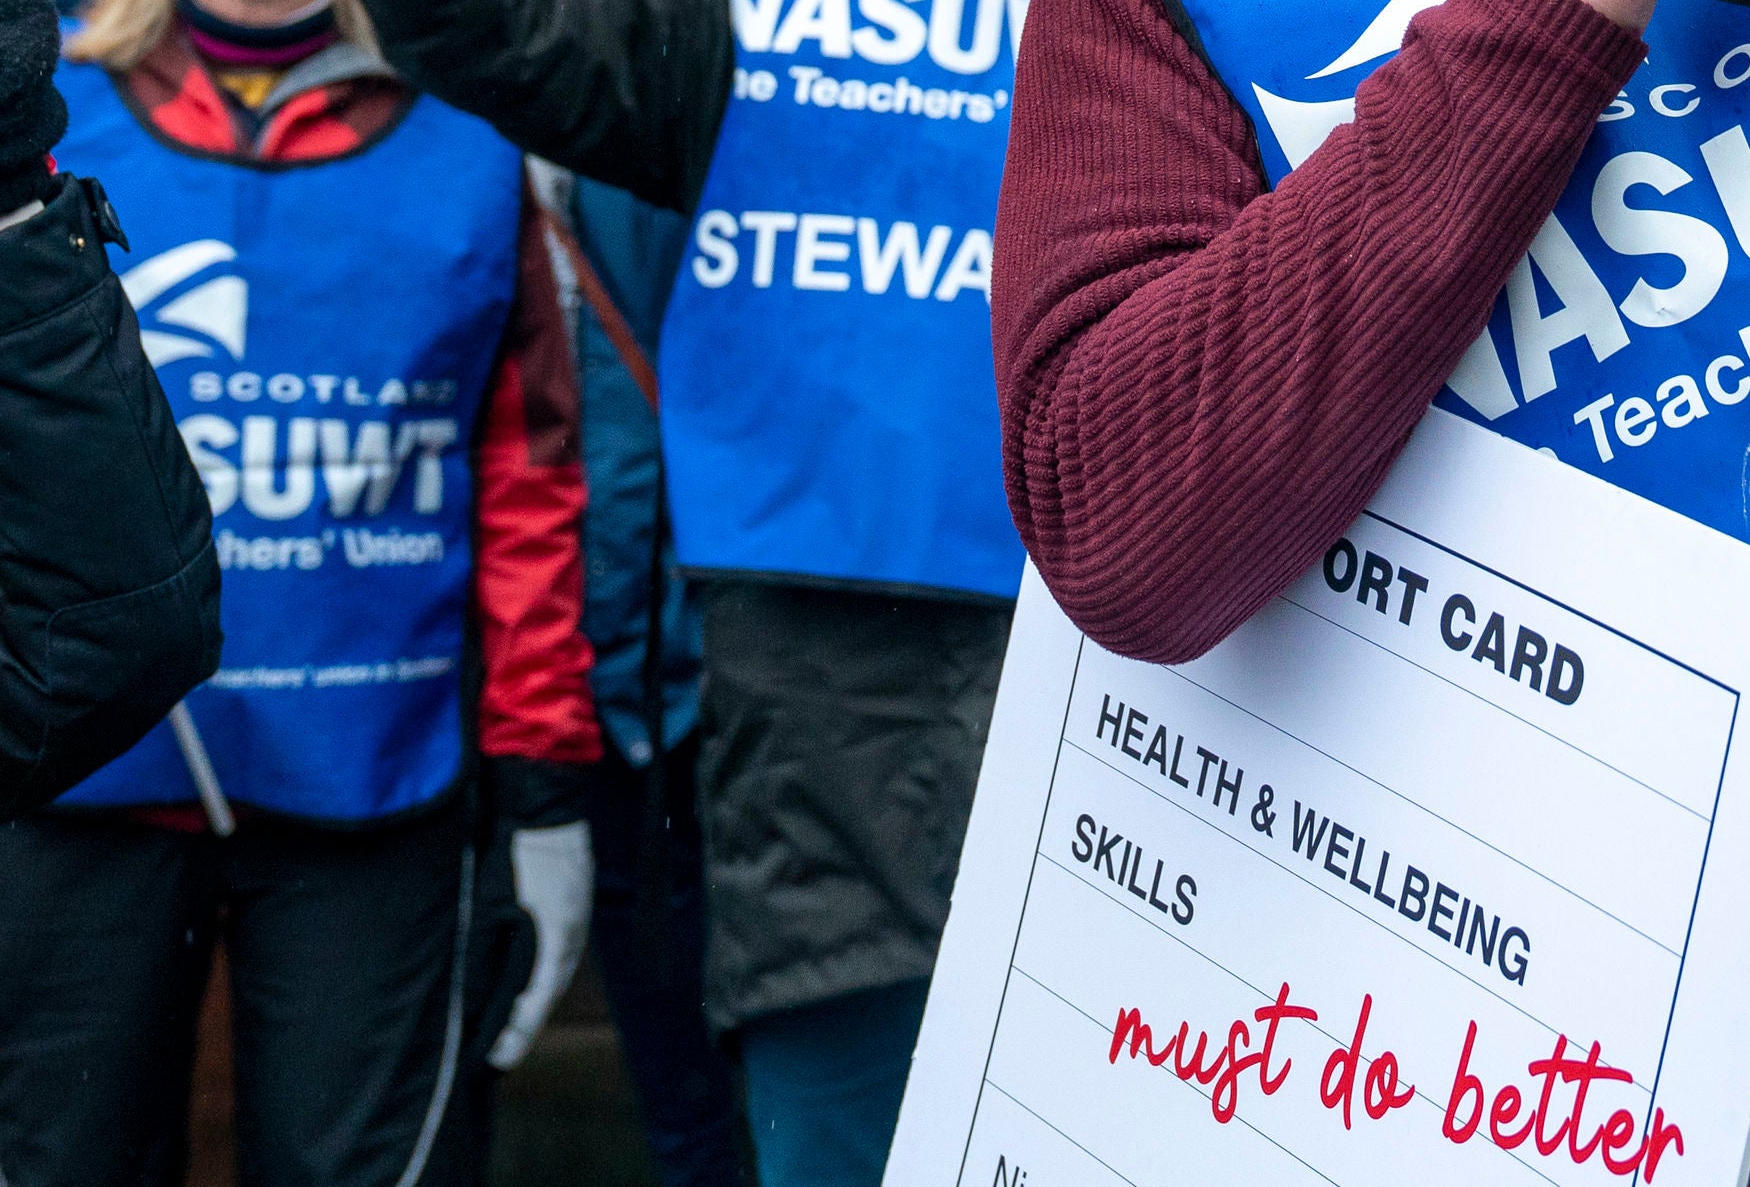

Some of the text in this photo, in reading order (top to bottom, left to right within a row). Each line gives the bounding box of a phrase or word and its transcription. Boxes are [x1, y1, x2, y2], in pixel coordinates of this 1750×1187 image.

[788, 65, 1009, 124] Teachers'
[342, 526, 446, 569] Union
[1322, 537, 1586, 708] ORT CARD
[1070, 812, 1199, 926] SKILLS
[1096, 694, 1532, 987] HEALTH & WELLBEING
[1108, 981, 1686, 1187] must do better
